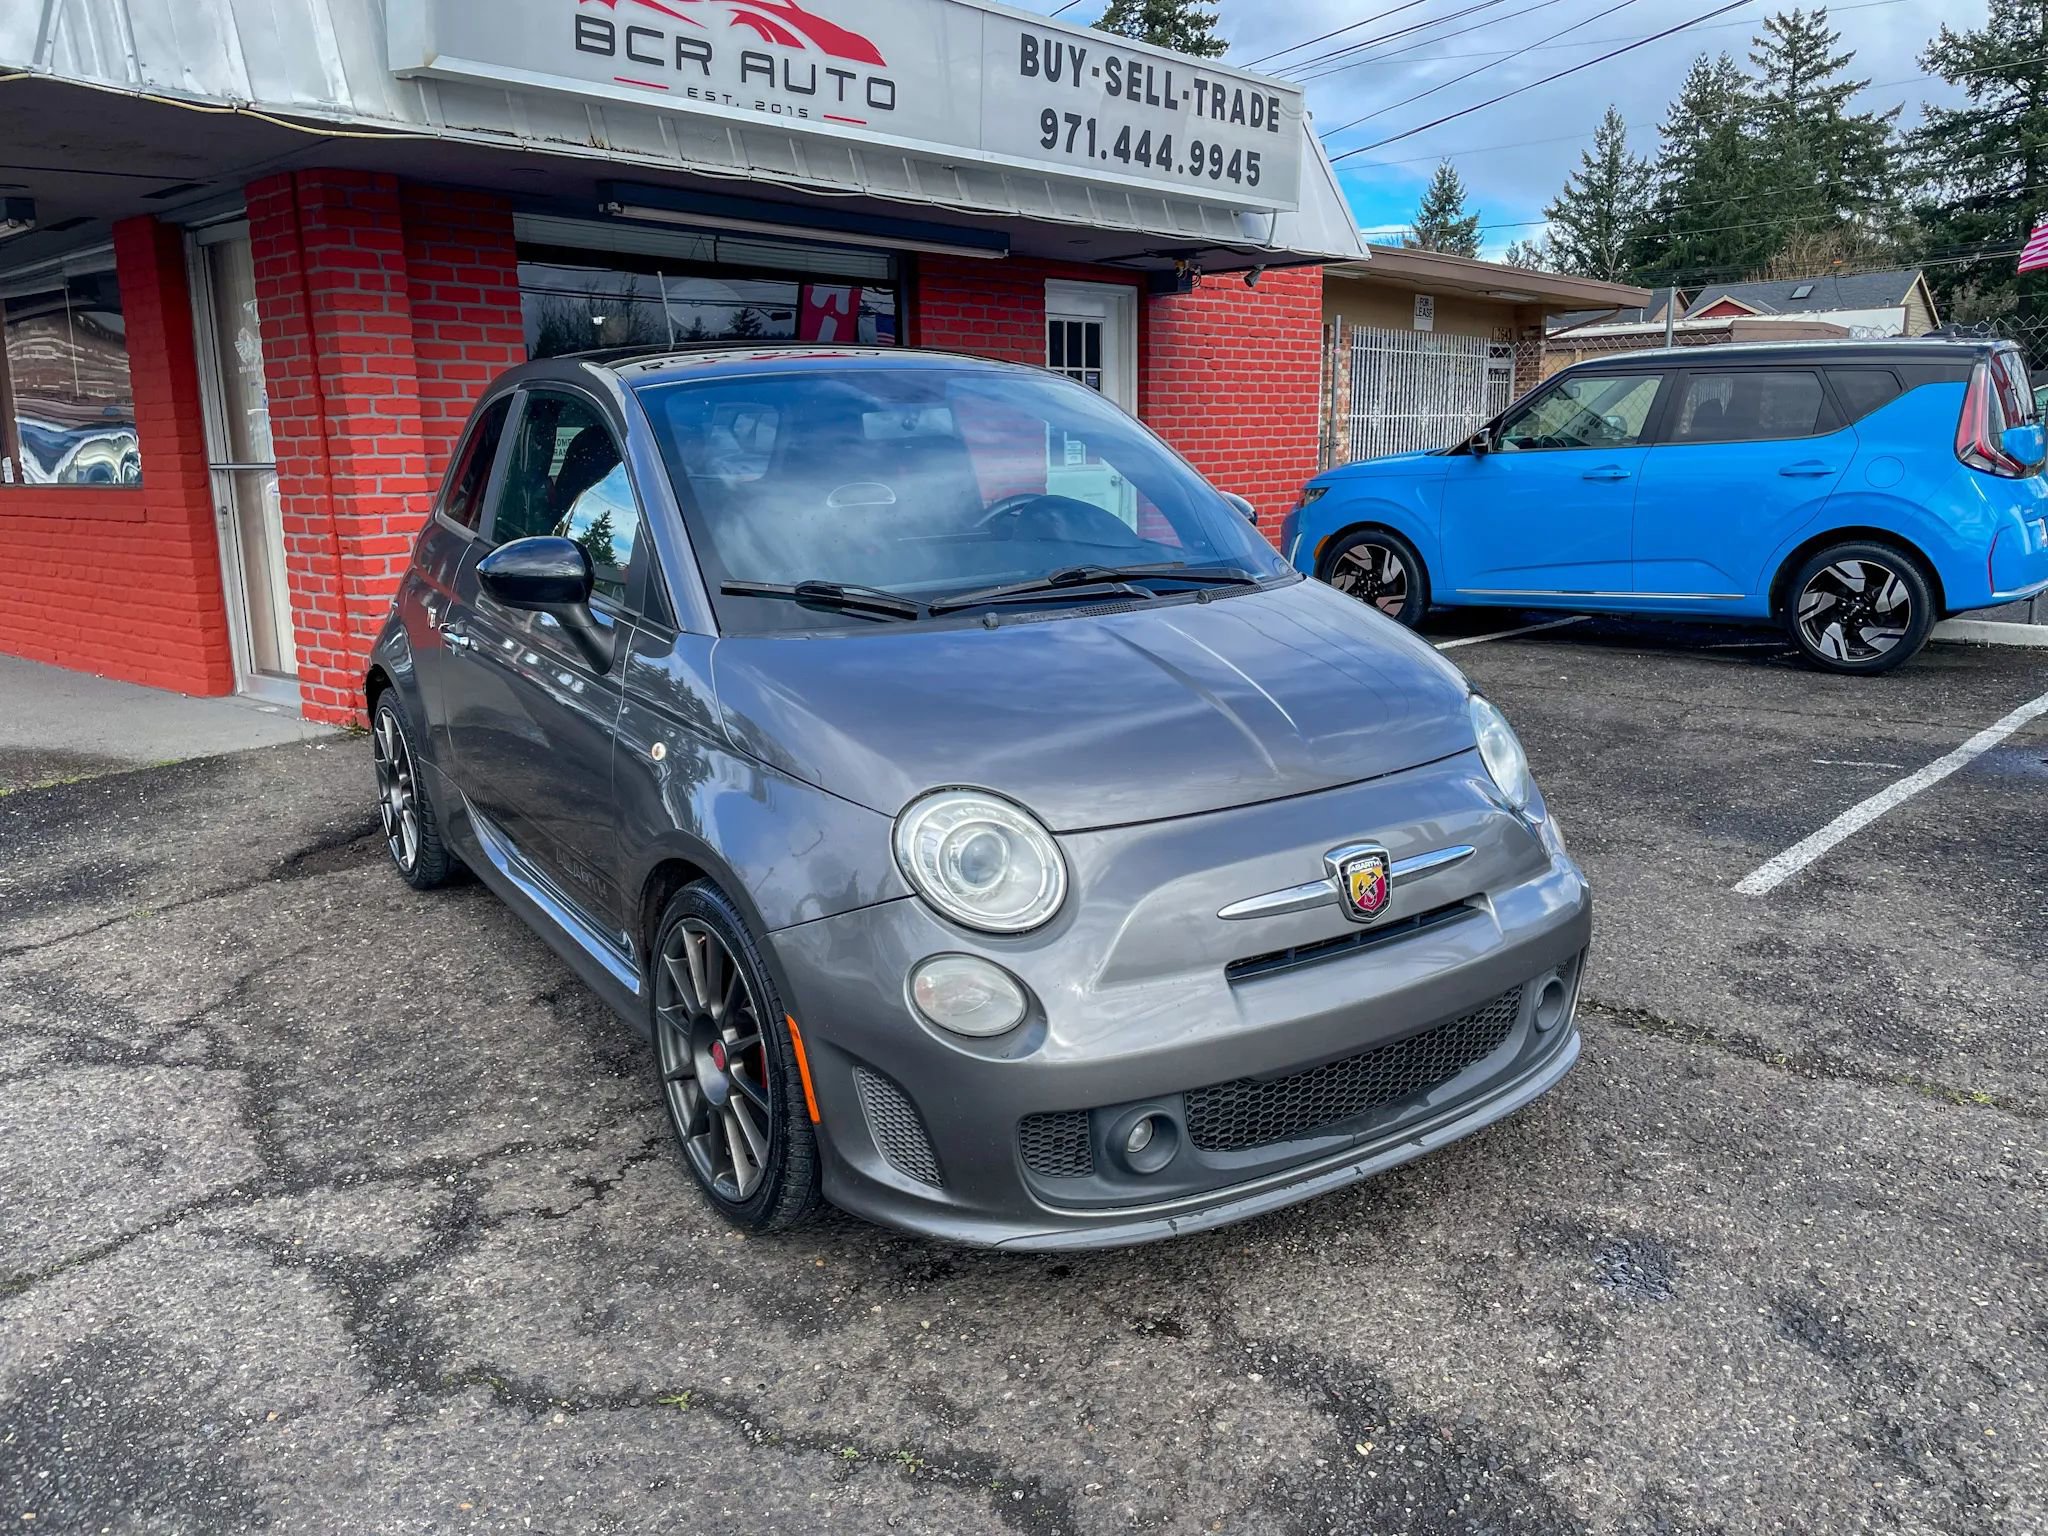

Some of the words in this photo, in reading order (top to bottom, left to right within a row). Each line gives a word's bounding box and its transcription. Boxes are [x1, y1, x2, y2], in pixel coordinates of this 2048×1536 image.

[575, 13, 713, 76] BCR
[741, 50, 896, 111] AUTO
[687, 87, 740, 107] EST.
[755, 100, 809, 118] 2015
[1039, 108, 1261, 187] 971.444.9945
[1415, 306, 1433, 318] LEASE
[1419, 297, 1430, 306] FOR
[1350, 859, 1381, 872] ABARTH
